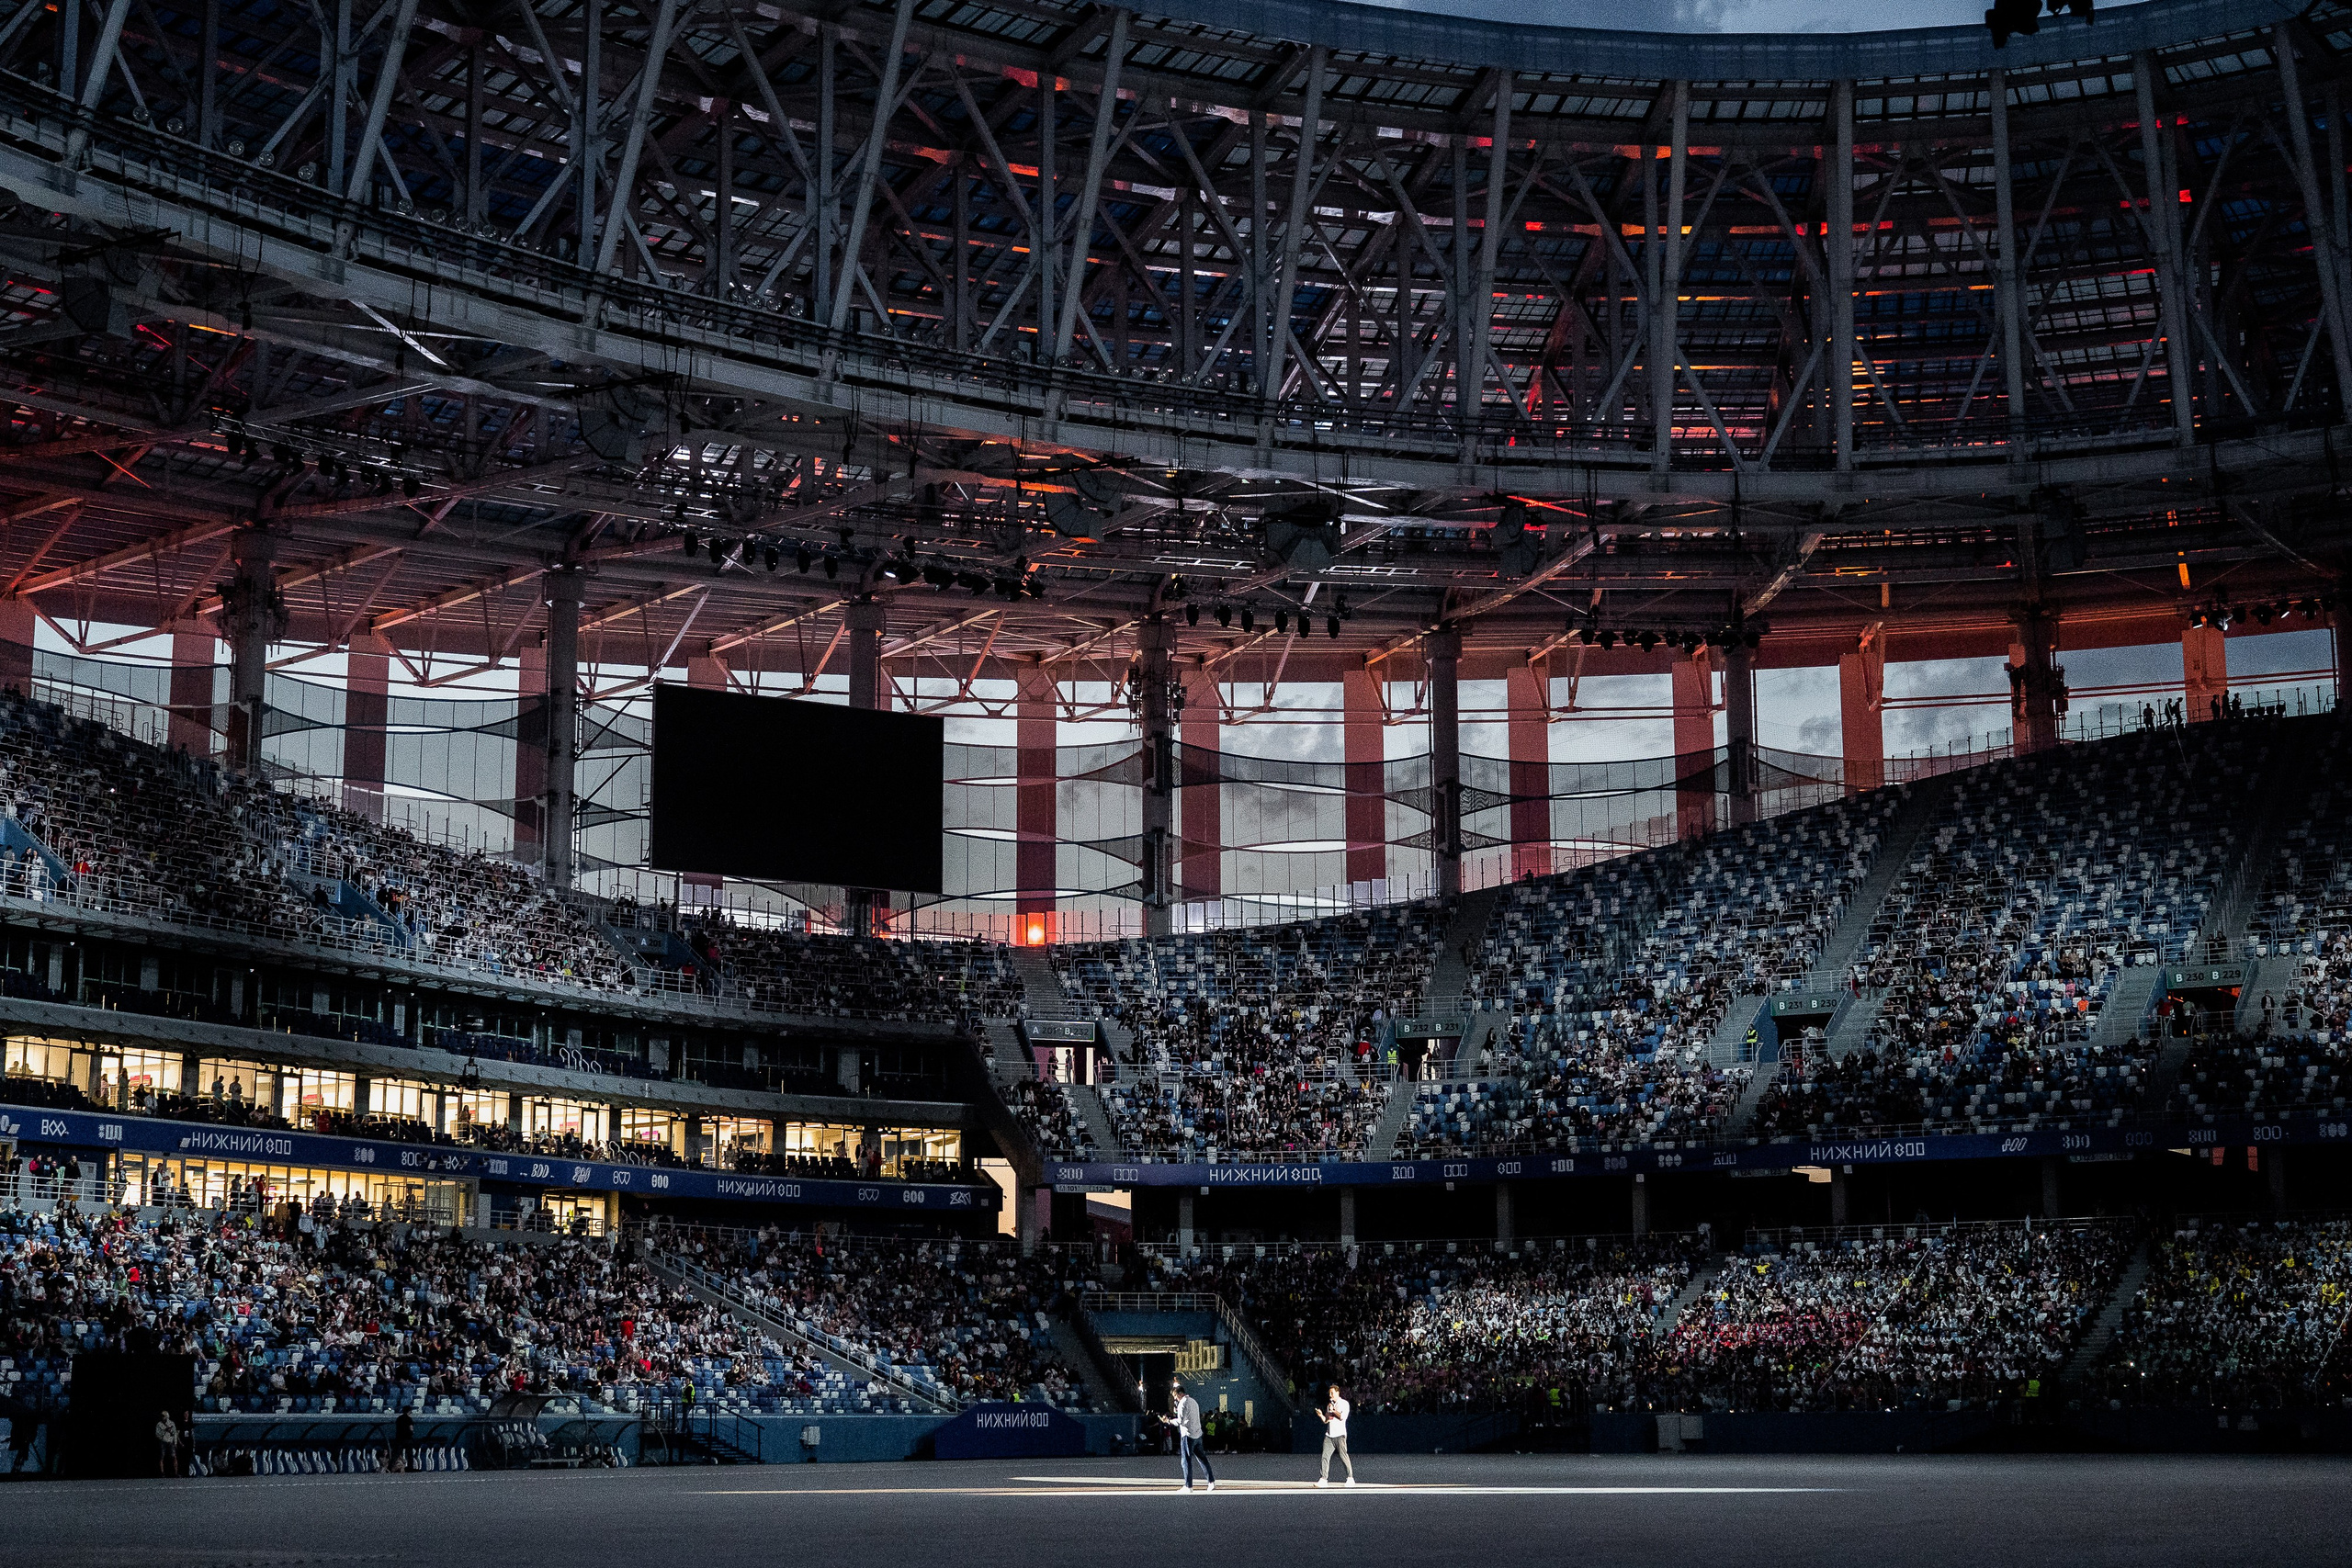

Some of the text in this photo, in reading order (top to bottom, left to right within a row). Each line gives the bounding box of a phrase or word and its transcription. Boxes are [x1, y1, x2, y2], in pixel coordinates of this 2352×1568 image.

[640, 937, 647, 946] A
[2176, 970, 2241, 982] B 230 B 229
[1779, 999, 1837, 1010] B 231 B 230
[1033, 1026, 1039, 1034] A
[1064, 1027, 1070, 1035] B
[1413, 1024, 1429, 1032] 232
[1435, 1023, 1442, 1032] B
